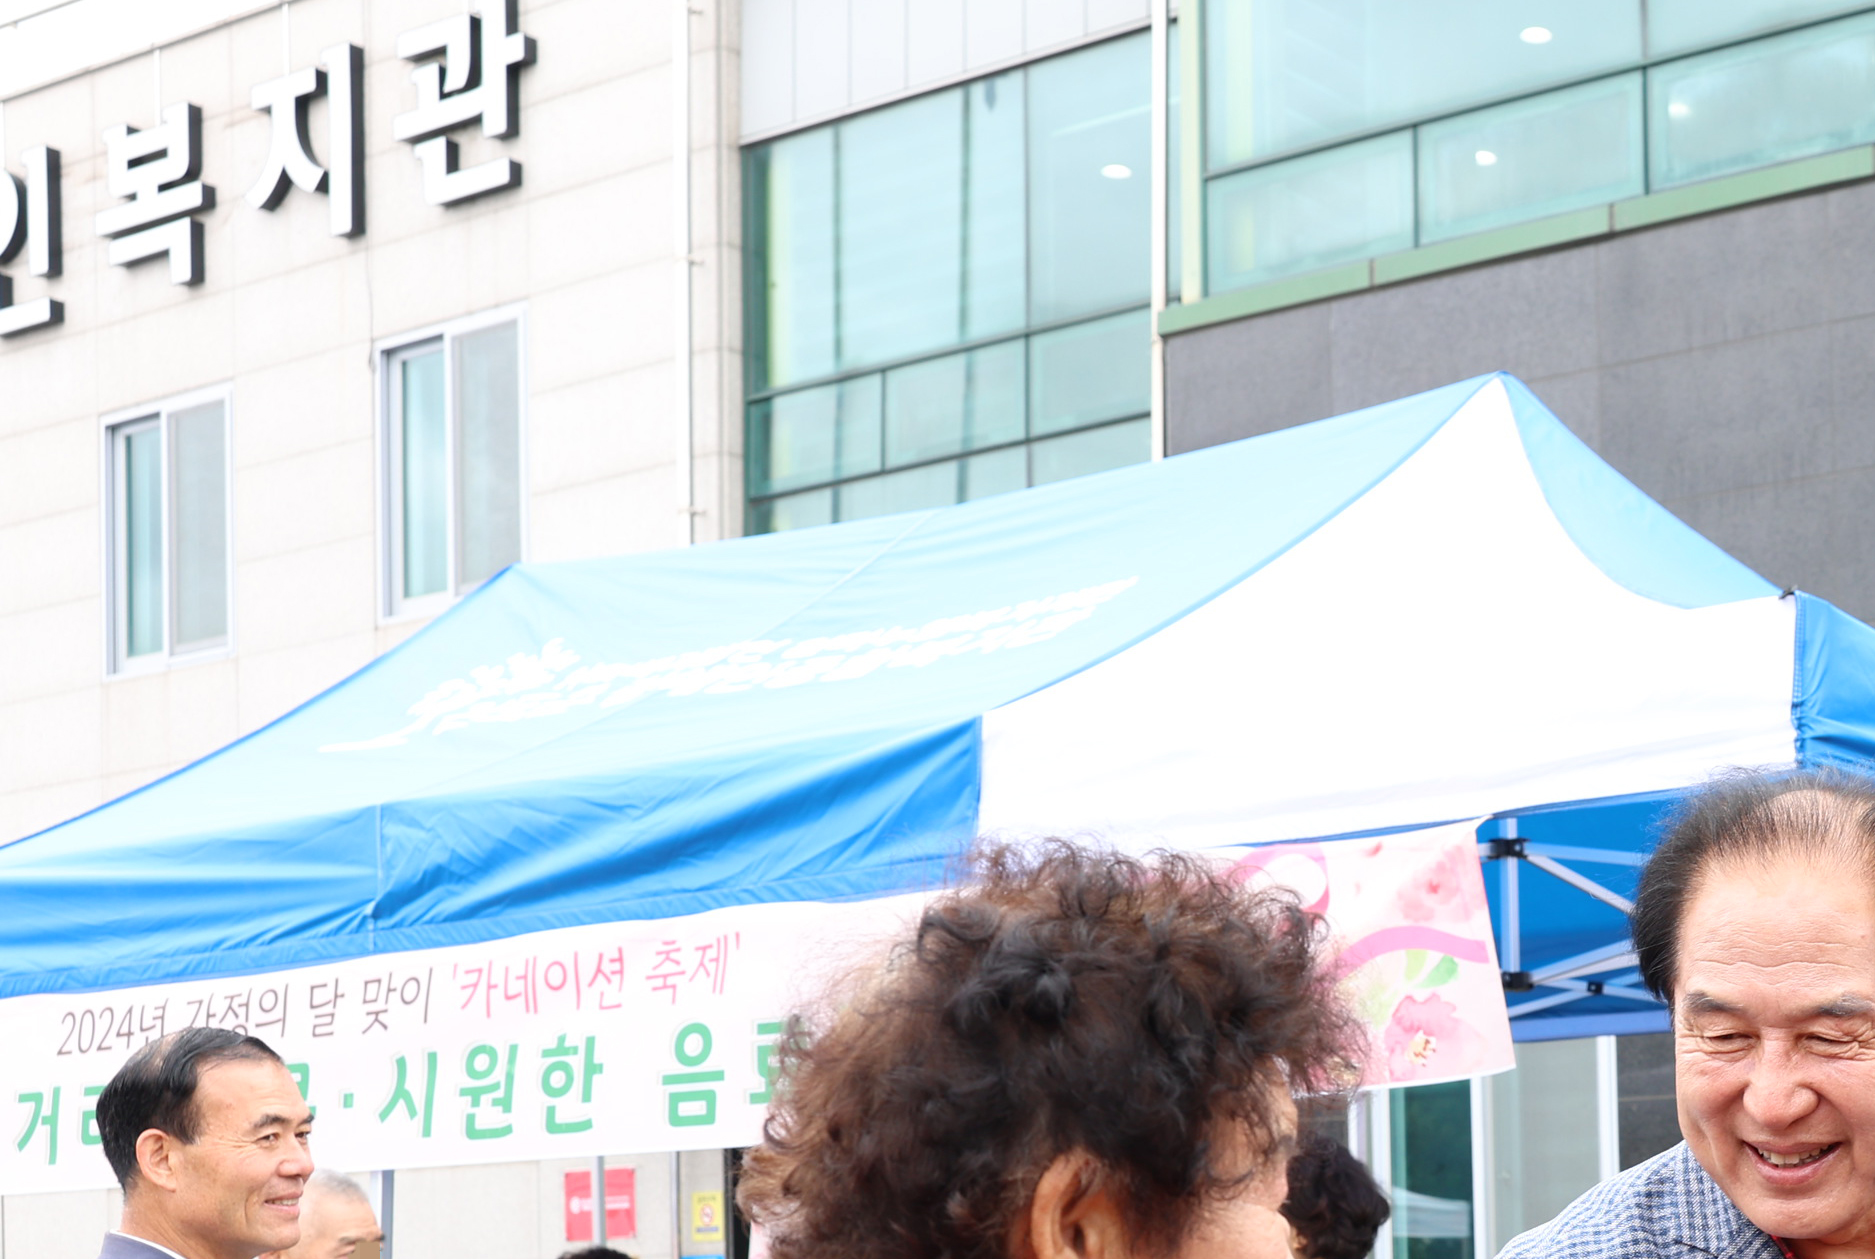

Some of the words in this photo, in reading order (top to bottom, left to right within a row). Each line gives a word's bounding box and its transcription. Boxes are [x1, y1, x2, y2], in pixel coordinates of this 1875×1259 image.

[56, 998, 169, 1056] 2024년
[309, 977, 345, 1039] 달
[361, 966, 433, 1035] 맞이
[452, 945, 625, 1019] '카네이션
[644, 931, 741, 1006] 축제'
